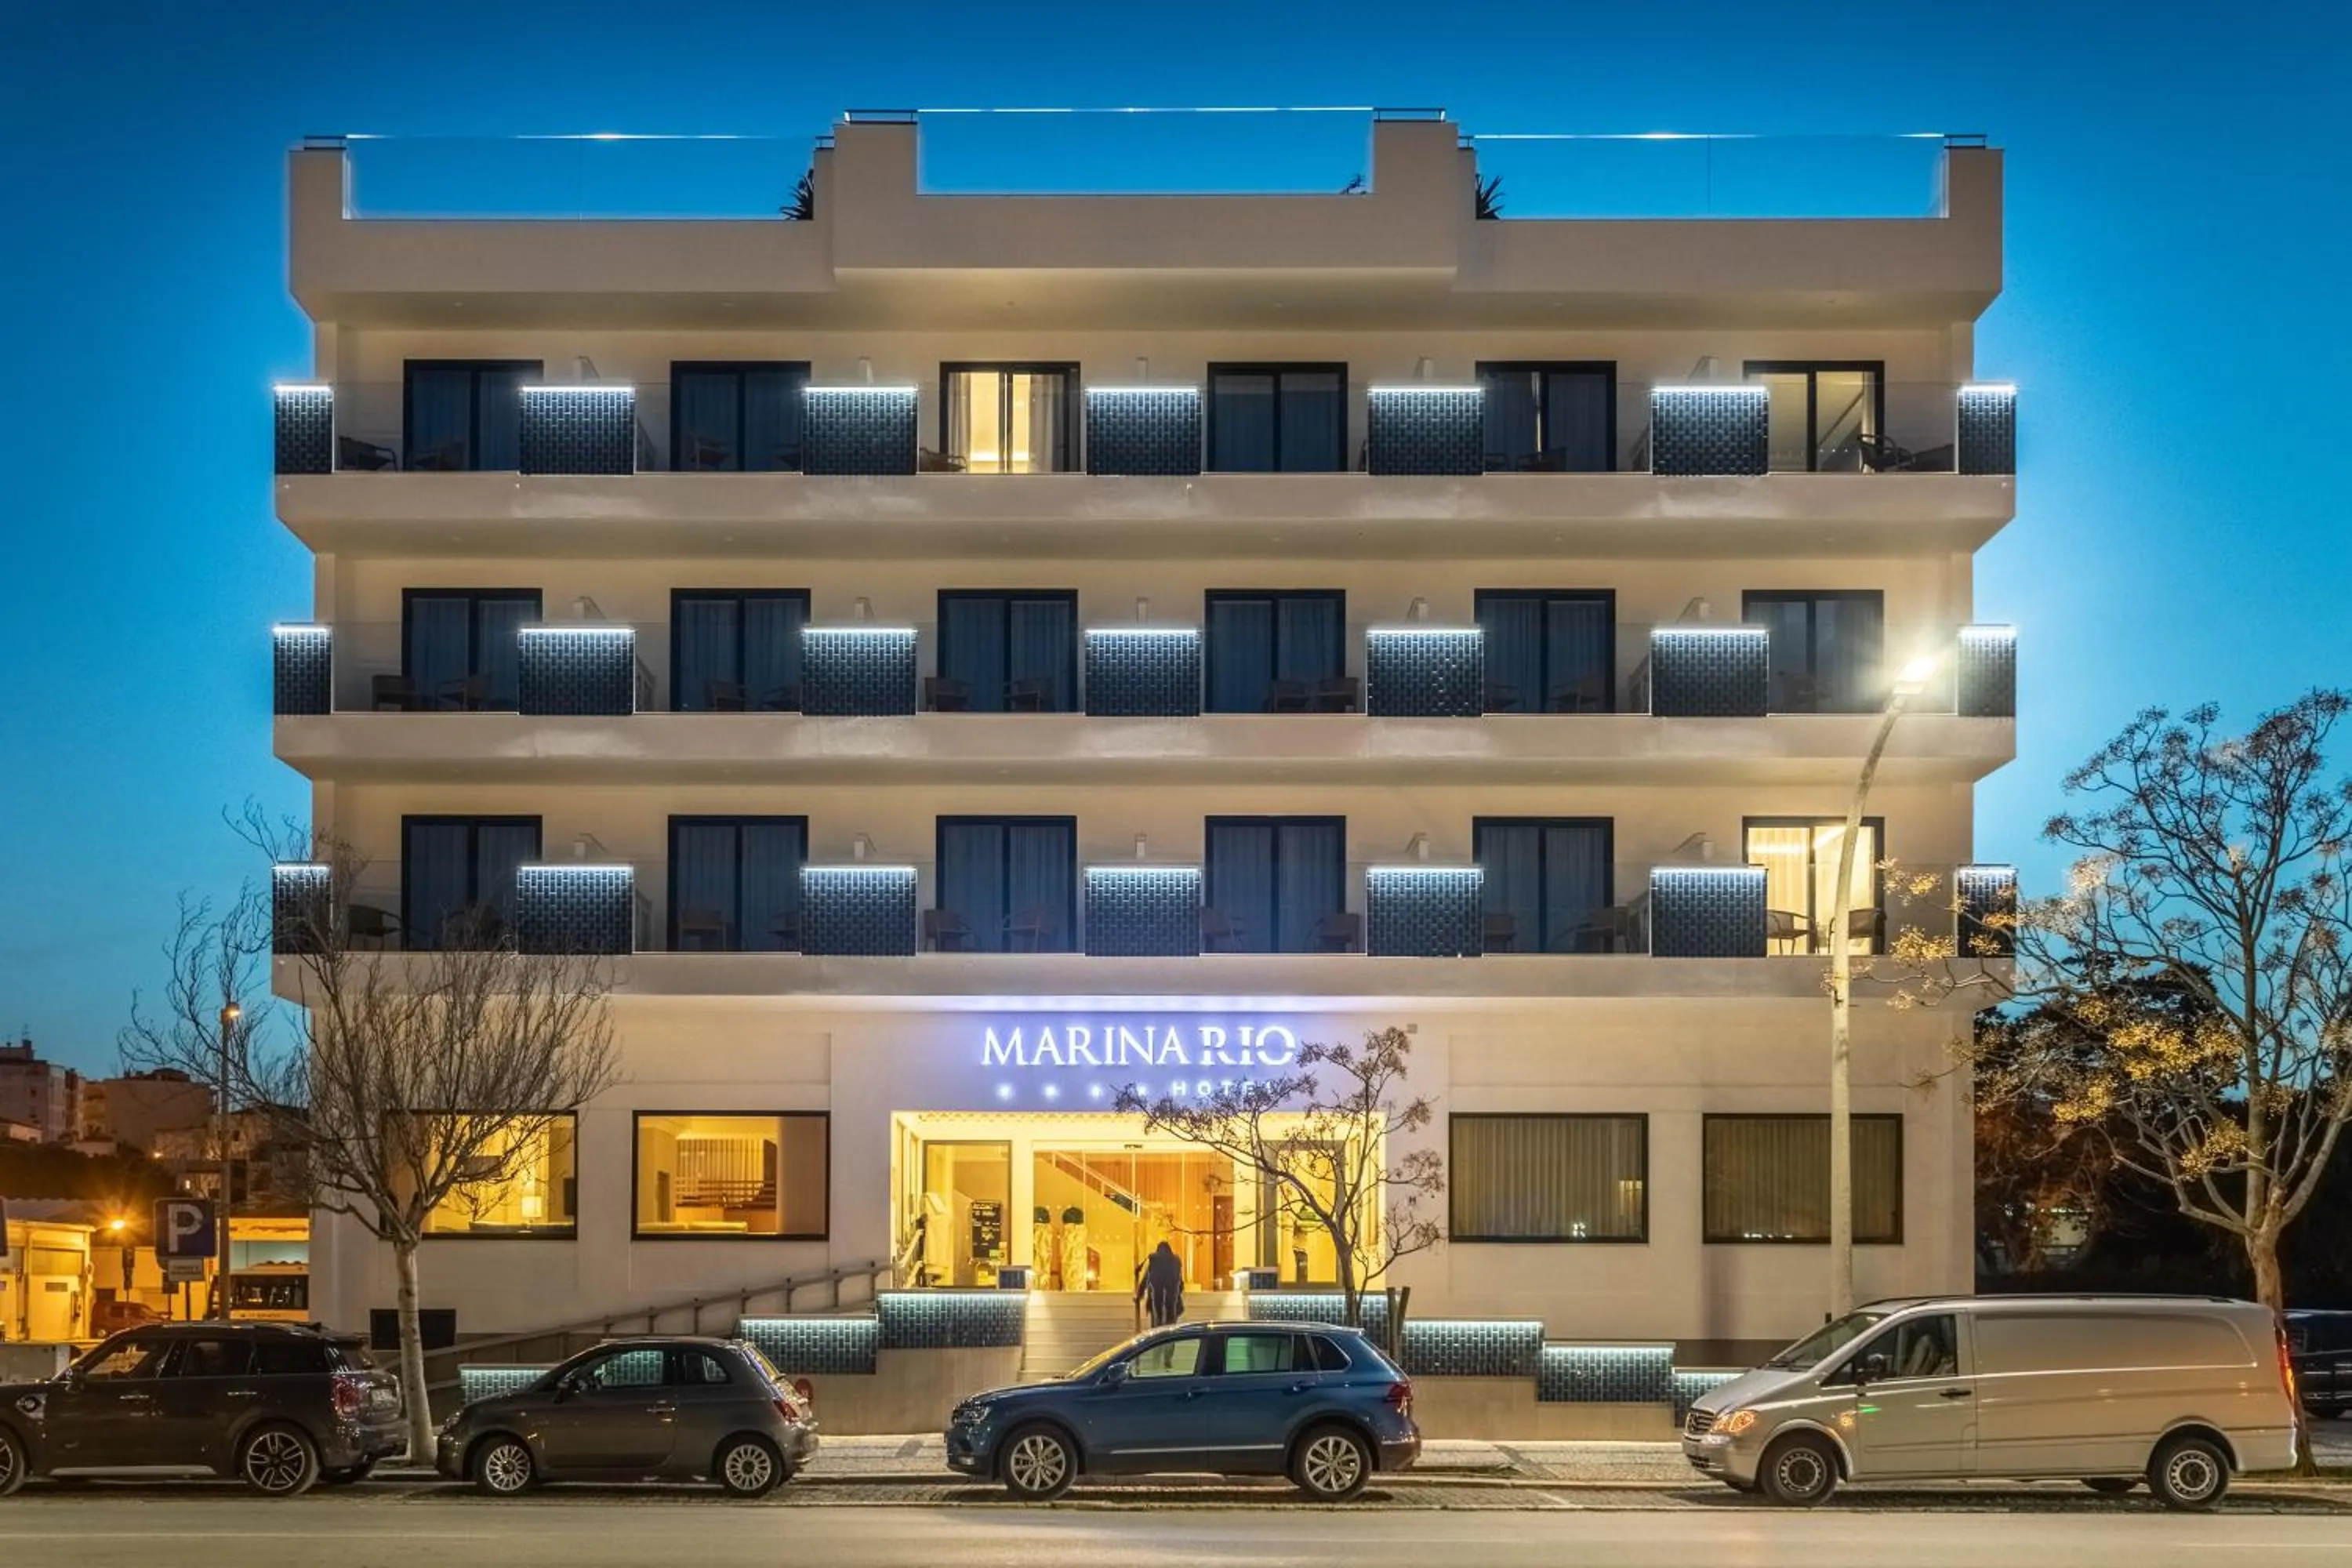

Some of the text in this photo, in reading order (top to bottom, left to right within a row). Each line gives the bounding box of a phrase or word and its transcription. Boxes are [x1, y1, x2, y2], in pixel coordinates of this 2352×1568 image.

[981, 1025, 1296, 1065] MARINA RIO
[168, 1204, 203, 1253] P
